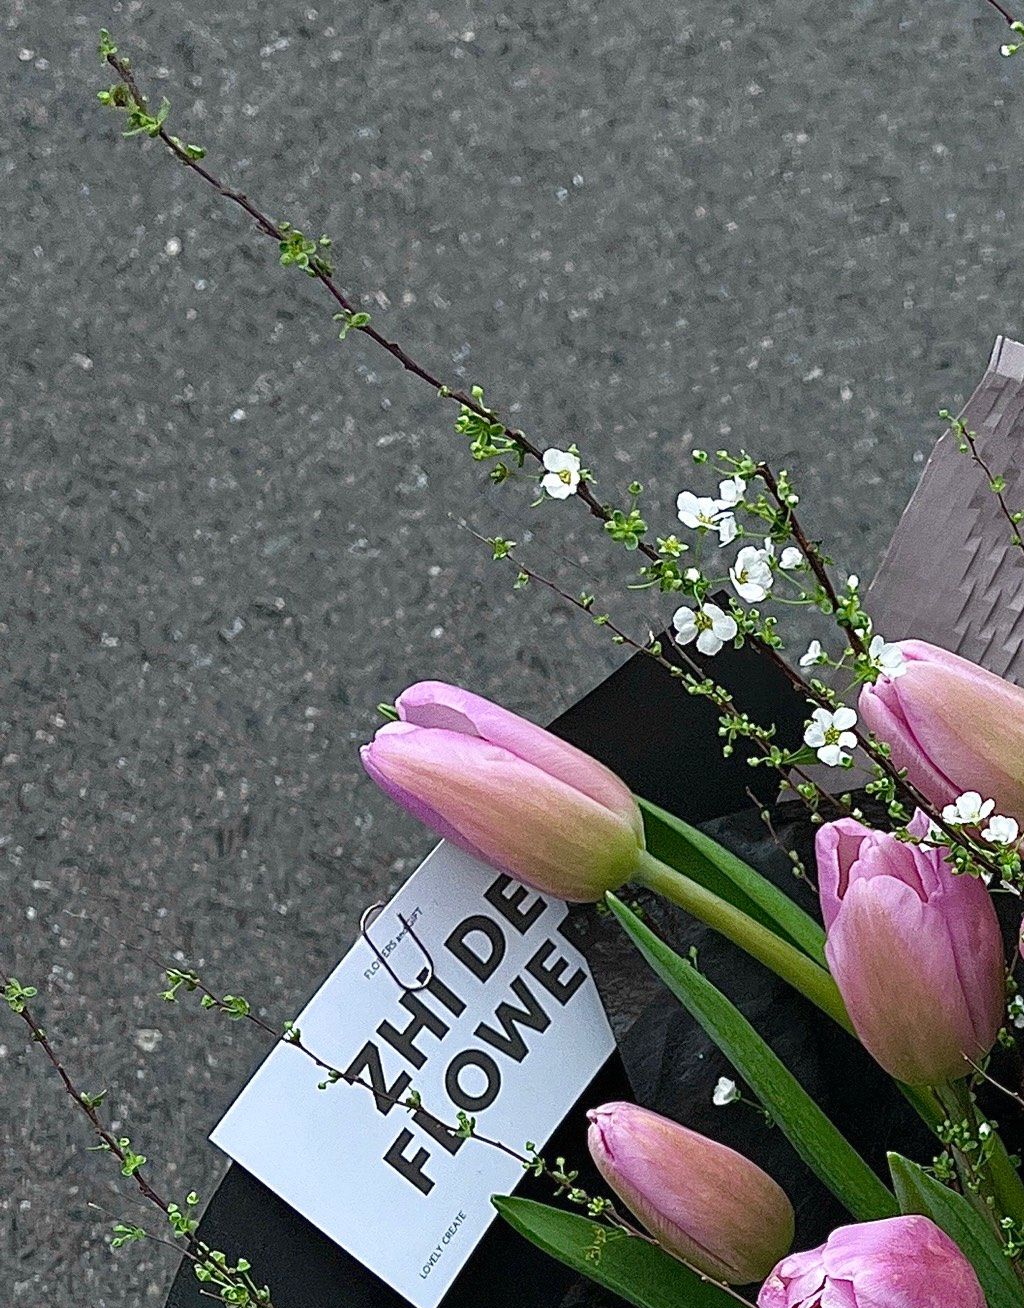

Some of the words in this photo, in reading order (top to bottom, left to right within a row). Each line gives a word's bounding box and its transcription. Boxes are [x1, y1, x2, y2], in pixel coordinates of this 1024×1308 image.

[342, 967, 467, 1116] ZHI
[444, 872, 548, 984] DE
[418, 1244, 444, 1280] LOVELY
[441, 1209, 467, 1245] CREATE
